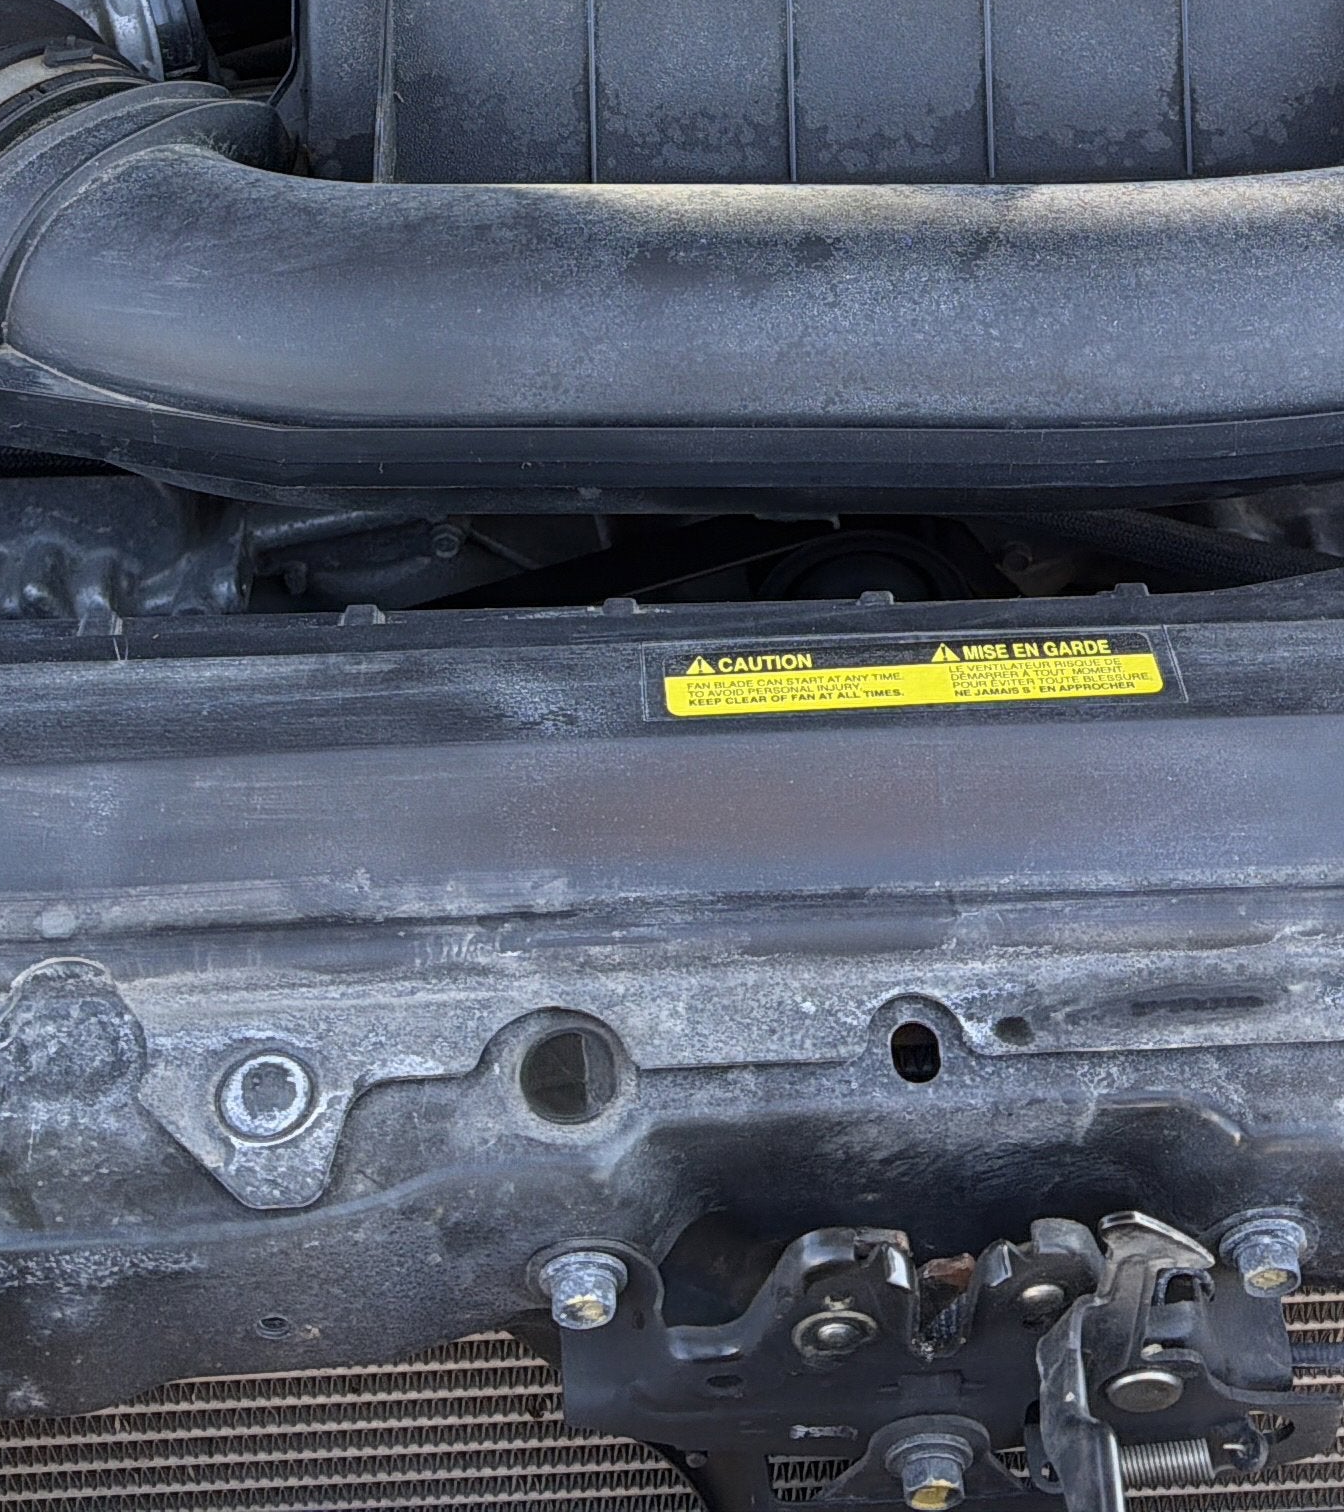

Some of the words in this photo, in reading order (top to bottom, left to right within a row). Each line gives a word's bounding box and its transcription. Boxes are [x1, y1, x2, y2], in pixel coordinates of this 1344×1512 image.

[963, 644, 1009, 661] MISE
[1013, 642, 1040, 658] EN
[1043, 639, 1111, 656] GARDE
[718, 654, 813, 673] CAUTION
[949, 664, 964, 673] LE
[967, 660, 1051, 672] VENTILATEUR
[1055, 658, 1101, 669] RISQUE
[1105, 657, 1122, 666] DE
[1033, 668, 1067, 678] TOUT
[687, 682, 711, 691] FAN
[714, 680, 754, 689] BLADE
[757, 677, 783, 687] CAN
[786, 675, 824, 685] START
[827, 675, 842, 683] AT
[844, 673, 869, 682] ANY
[953, 680, 988, 690] POUR
[1038, 674, 1080, 684] TOUTE
[955, 688, 971, 697] NE
[975, 686, 1019, 696] JAMAIS
[1040, 684, 1057, 694] EN
[1060, 681, 1135, 693] APPROCHER
[688, 690, 704, 699] TO
[708, 688, 744, 697] AVOID
[748, 684, 814, 695] PERSONAL
[688, 697, 722, 707] KEEP
[725, 695, 767, 705] CLEAR
[771, 694, 788, 703] OF
[791, 693, 816, 702] FAN
[819, 692, 834, 700] AT
[837, 690, 860, 699] ALL
[863, 688, 904, 698] TIMES.
